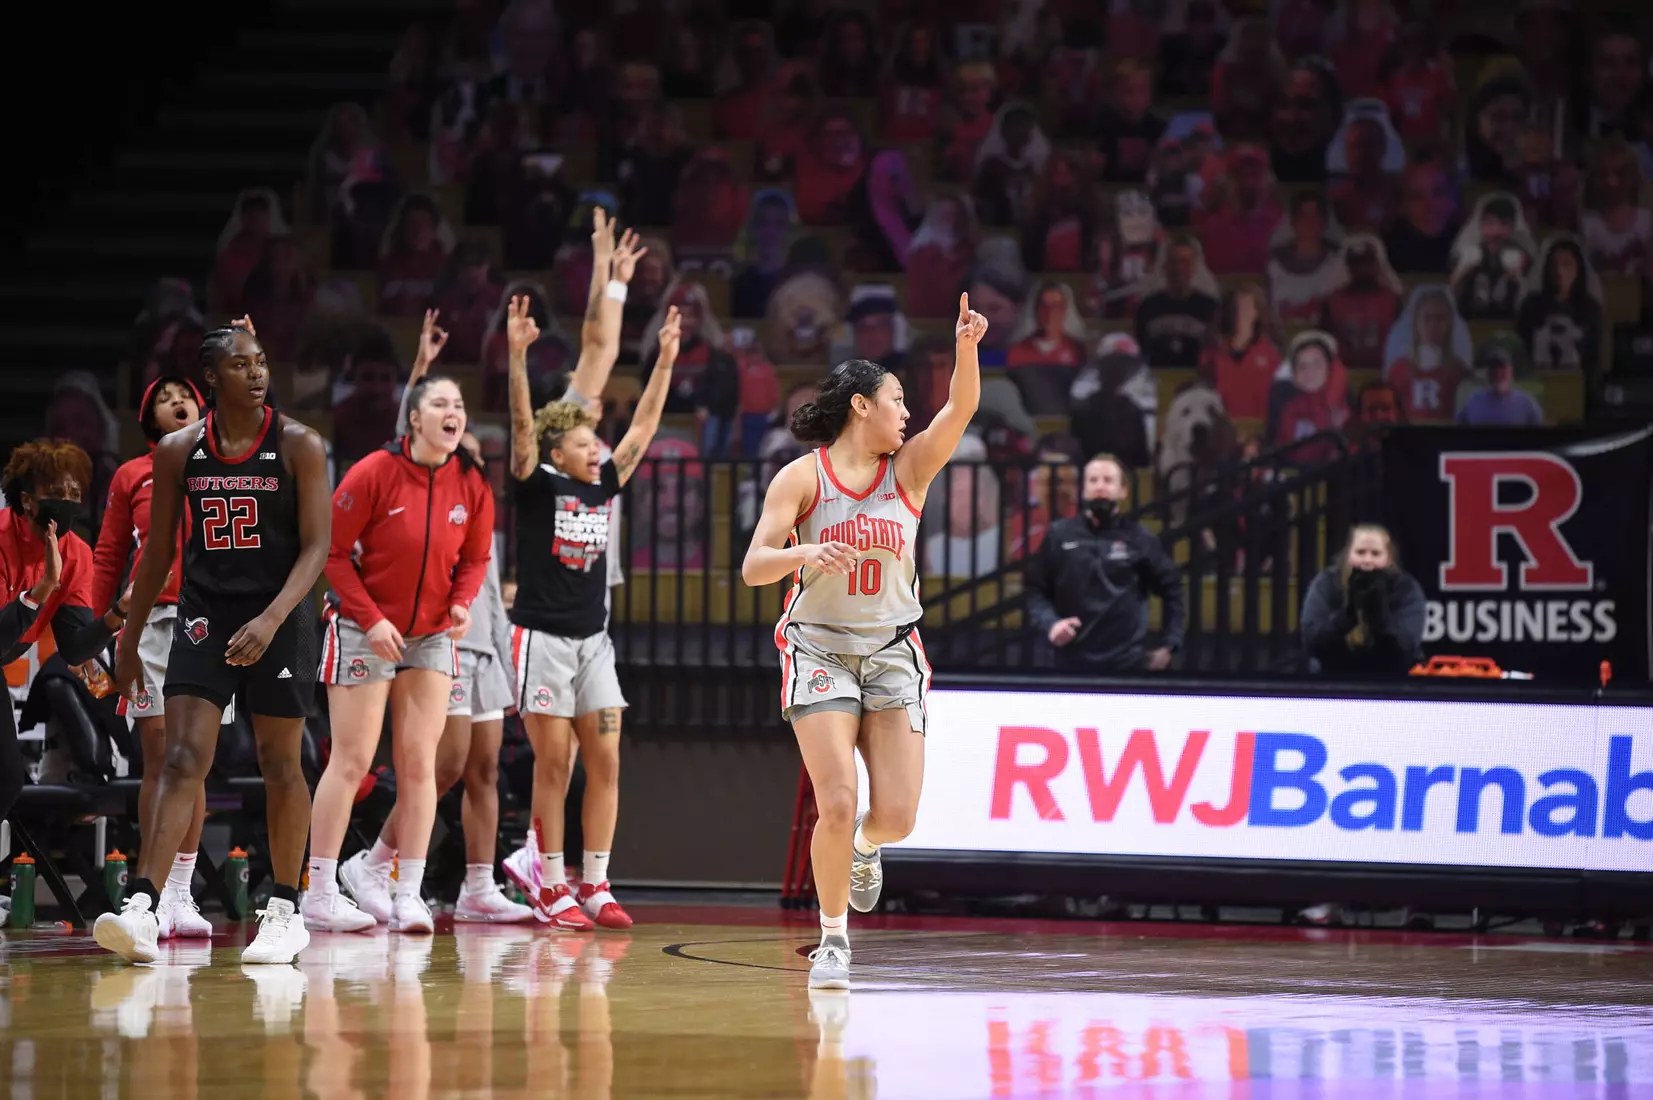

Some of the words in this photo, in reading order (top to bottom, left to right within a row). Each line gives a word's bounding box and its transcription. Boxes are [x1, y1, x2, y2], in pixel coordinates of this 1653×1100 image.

[187, 476, 279, 491] RUTGERS
[201, 496, 261, 550] 22
[1439, 452, 1593, 591] R
[848, 559, 881, 595] 10
[1422, 601, 1617, 642] BUSINESS
